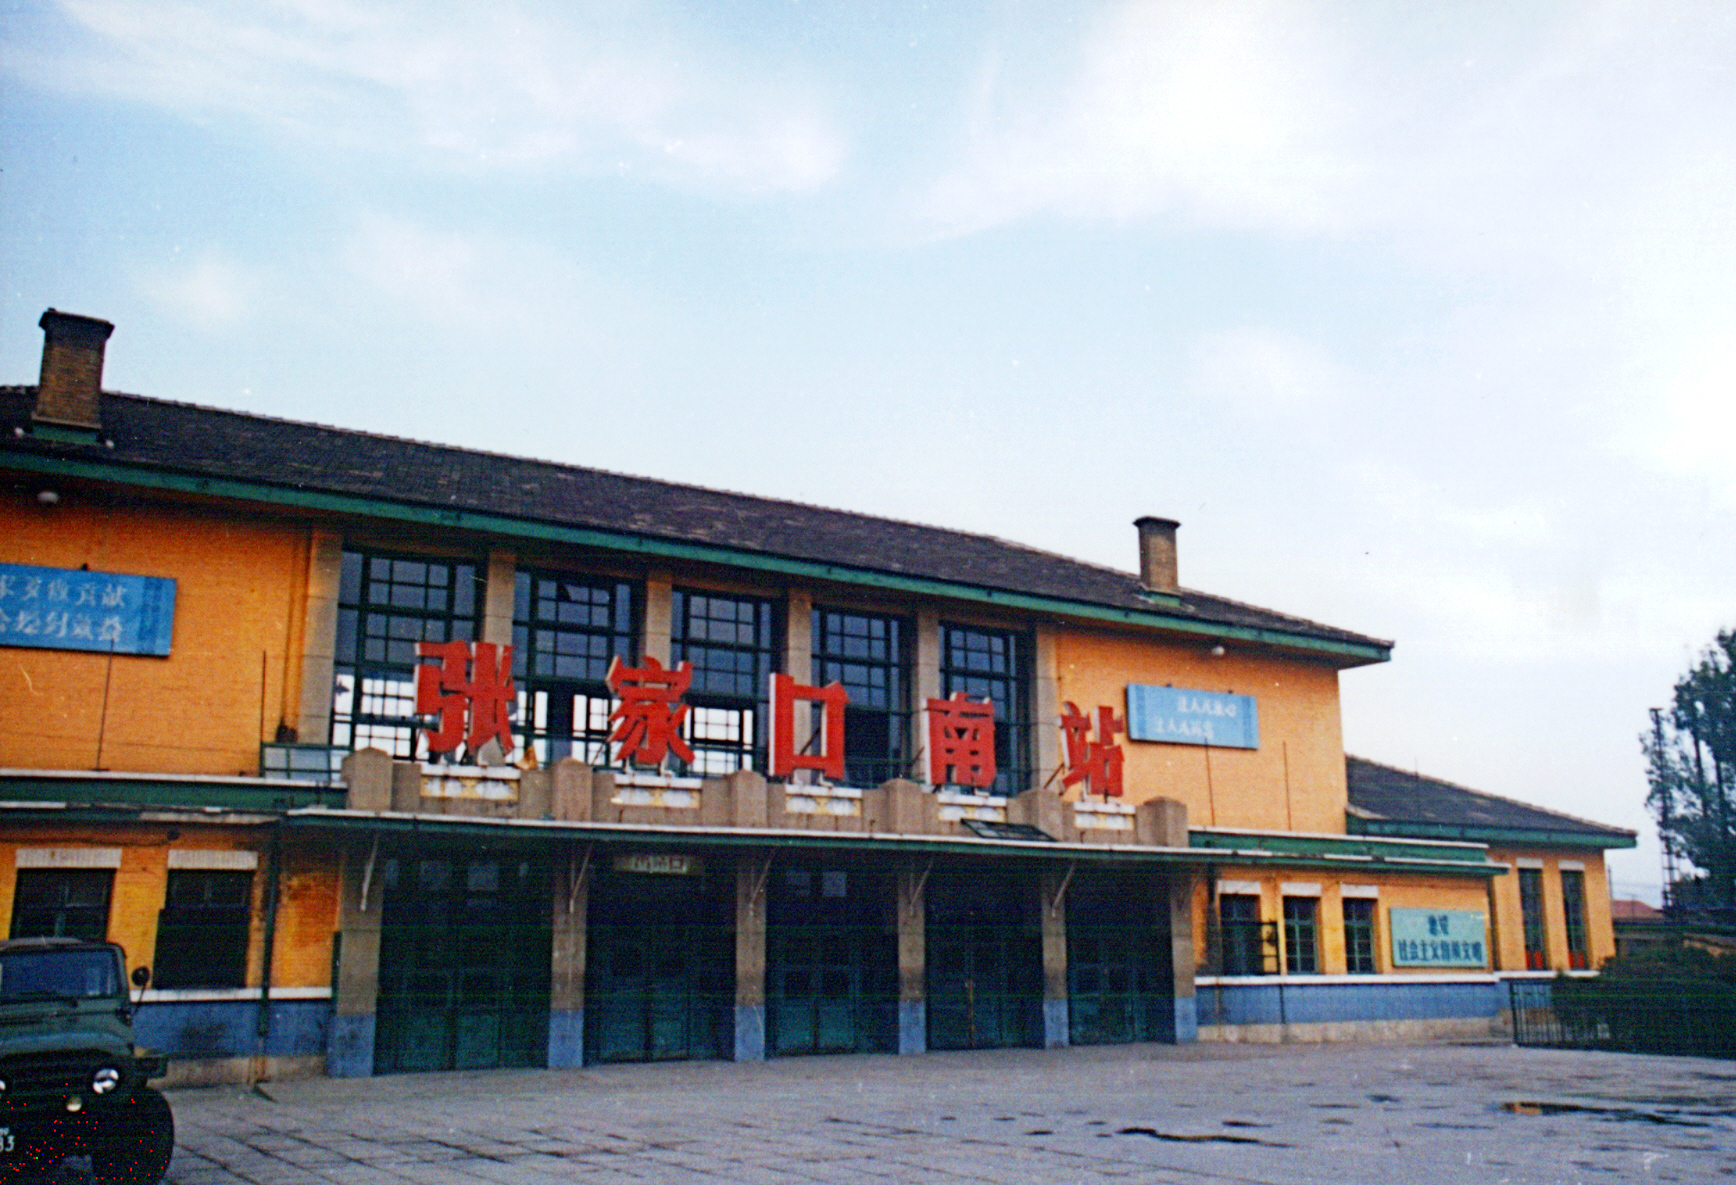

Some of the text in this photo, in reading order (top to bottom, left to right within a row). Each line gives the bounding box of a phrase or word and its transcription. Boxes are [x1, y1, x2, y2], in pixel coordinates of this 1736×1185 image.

[413, 639, 1124, 798] 张家口南站
